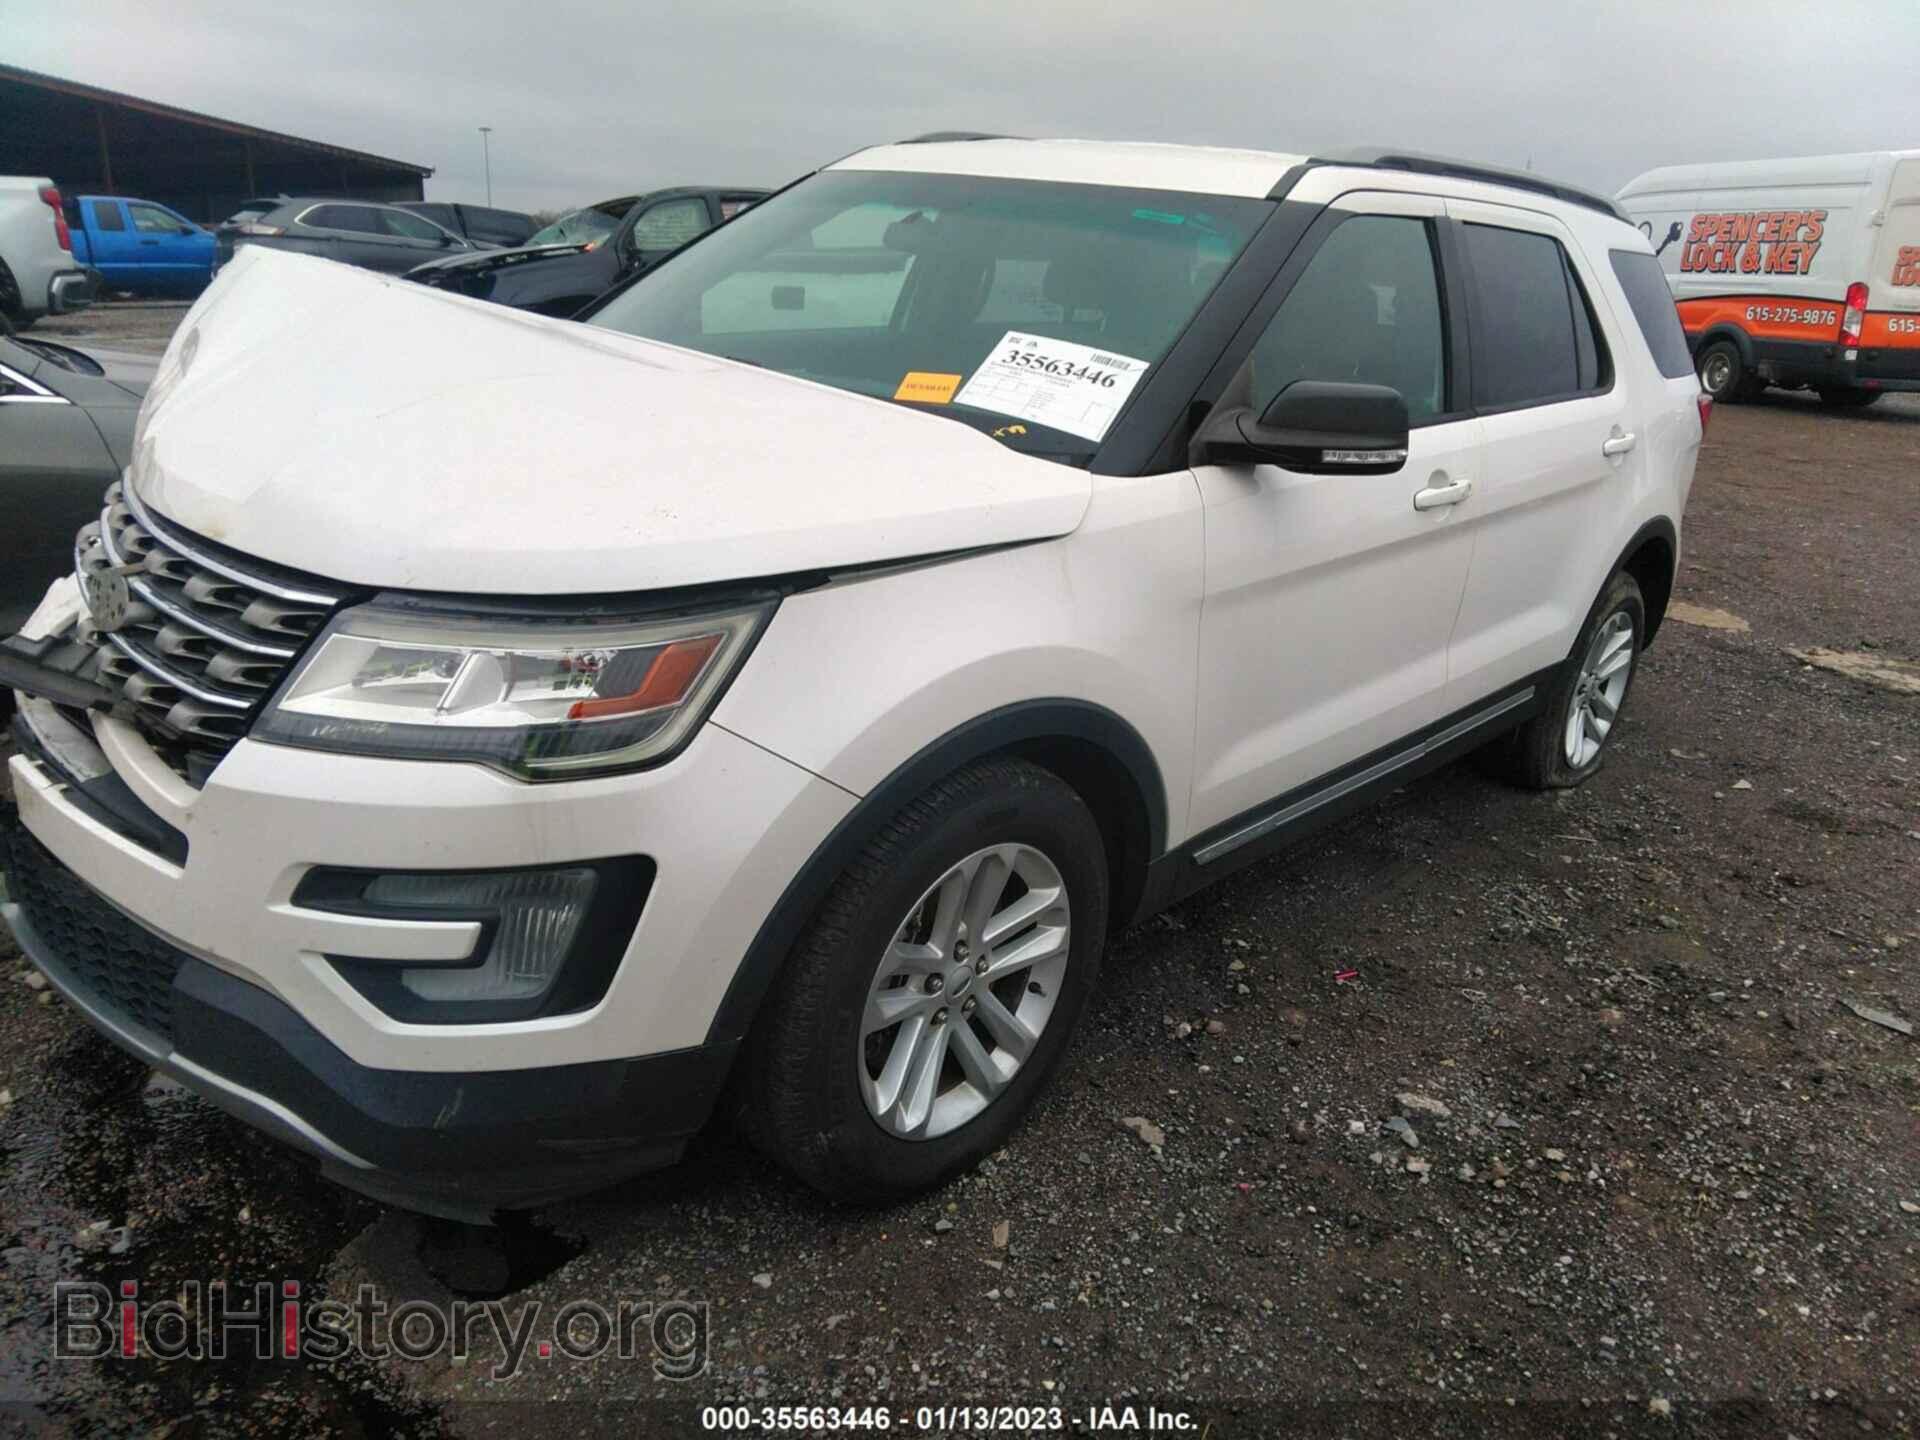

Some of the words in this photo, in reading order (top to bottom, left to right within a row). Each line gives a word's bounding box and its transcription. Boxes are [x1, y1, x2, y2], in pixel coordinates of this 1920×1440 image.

[1689, 209, 1827, 243] SPENCER'S
[1680, 241, 1738, 273] LOCK
[1740, 245, 1760, 273] &
[1764, 242, 1821, 274] KEY
[1746, 306, 1836, 326] 615-275-9876
[1002, 350, 1118, 389] 35563446
